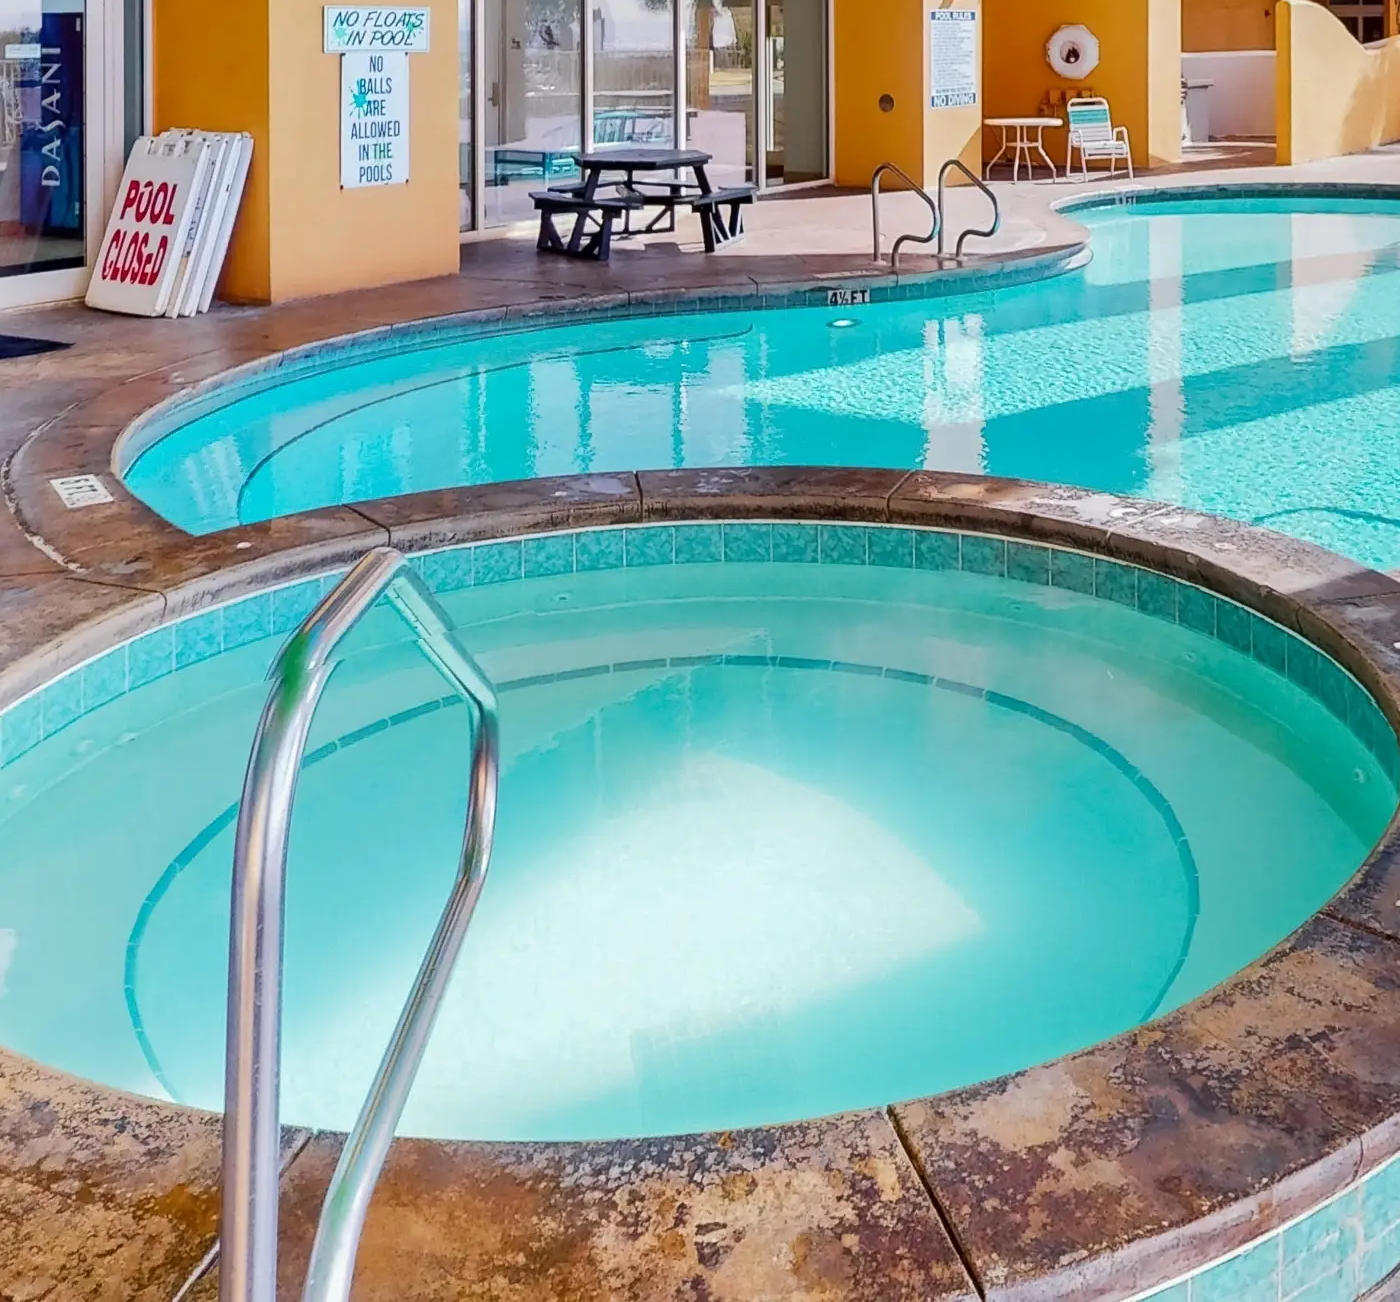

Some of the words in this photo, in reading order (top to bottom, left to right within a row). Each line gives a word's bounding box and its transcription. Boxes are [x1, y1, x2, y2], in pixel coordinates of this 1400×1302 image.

[333, 11, 360, 27] NO
[363, 11, 425, 28] FLOATS
[345, 30, 366, 46] IN
[369, 30, 414, 46] POOL
[369, 55, 384, 73] NO
[358, 77, 393, 95] BALLS
[365, 99, 386, 117] ARE
[935, 95, 946, 107] NO
[949, 93, 973, 105] DIVING
[41, 47, 67, 187] DASANI
[351, 120, 401, 140] ALLOWED
[359, 144, 370, 162] IN
[373, 142, 393, 160] THE
[359, 163, 393, 184] POOLS
[119, 180, 179, 226] POOL
[101, 228, 168, 286] CLOSED
